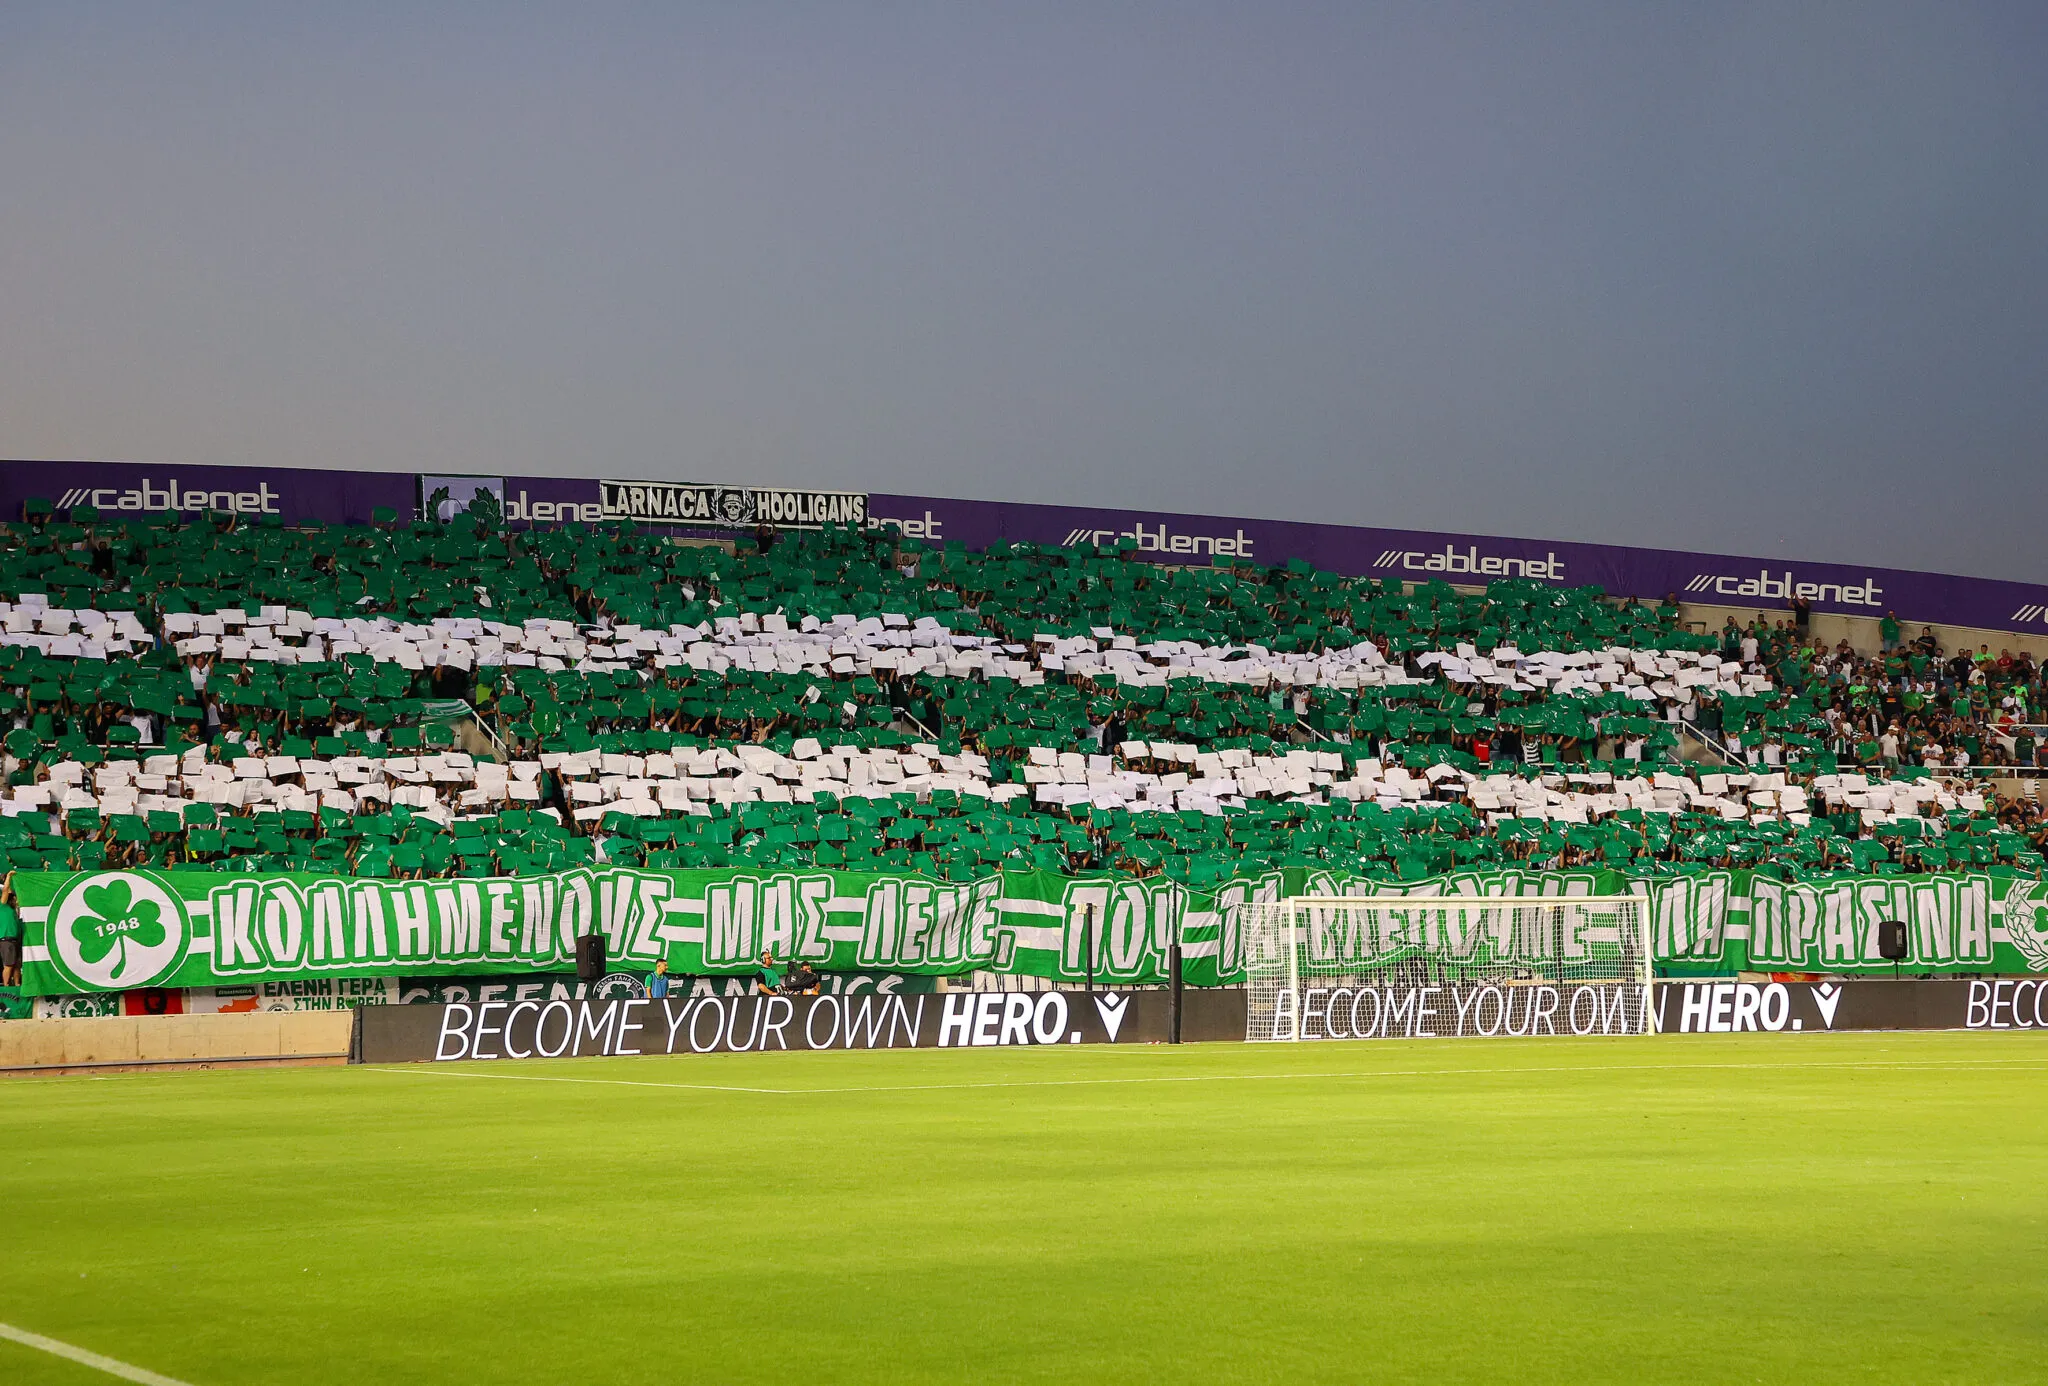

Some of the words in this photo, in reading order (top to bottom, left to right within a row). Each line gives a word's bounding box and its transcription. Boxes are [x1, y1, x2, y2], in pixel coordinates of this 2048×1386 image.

[91, 478, 280, 513] cablenet
[603, 486, 711, 518] LARNACA
[757, 492, 864, 523] HOOLIGANS
[1402, 544, 1565, 581] cablenet
[1715, 570, 1883, 606] cablenet
[94, 917, 140, 938] 1948
[704, 873, 834, 966] ΜΑΣ
[436, 999, 650, 1060] BECOME
[660, 995, 794, 1053] YOUR
[805, 993, 924, 1049] OWN
[938, 991, 1081, 1047] HERO.
[1273, 987, 1442, 1040] BECOME
[1451, 986, 1559, 1036] YOUR
[1569, 984, 1668, 1035] OWN
[1680, 983, 1802, 1033] HERO.
